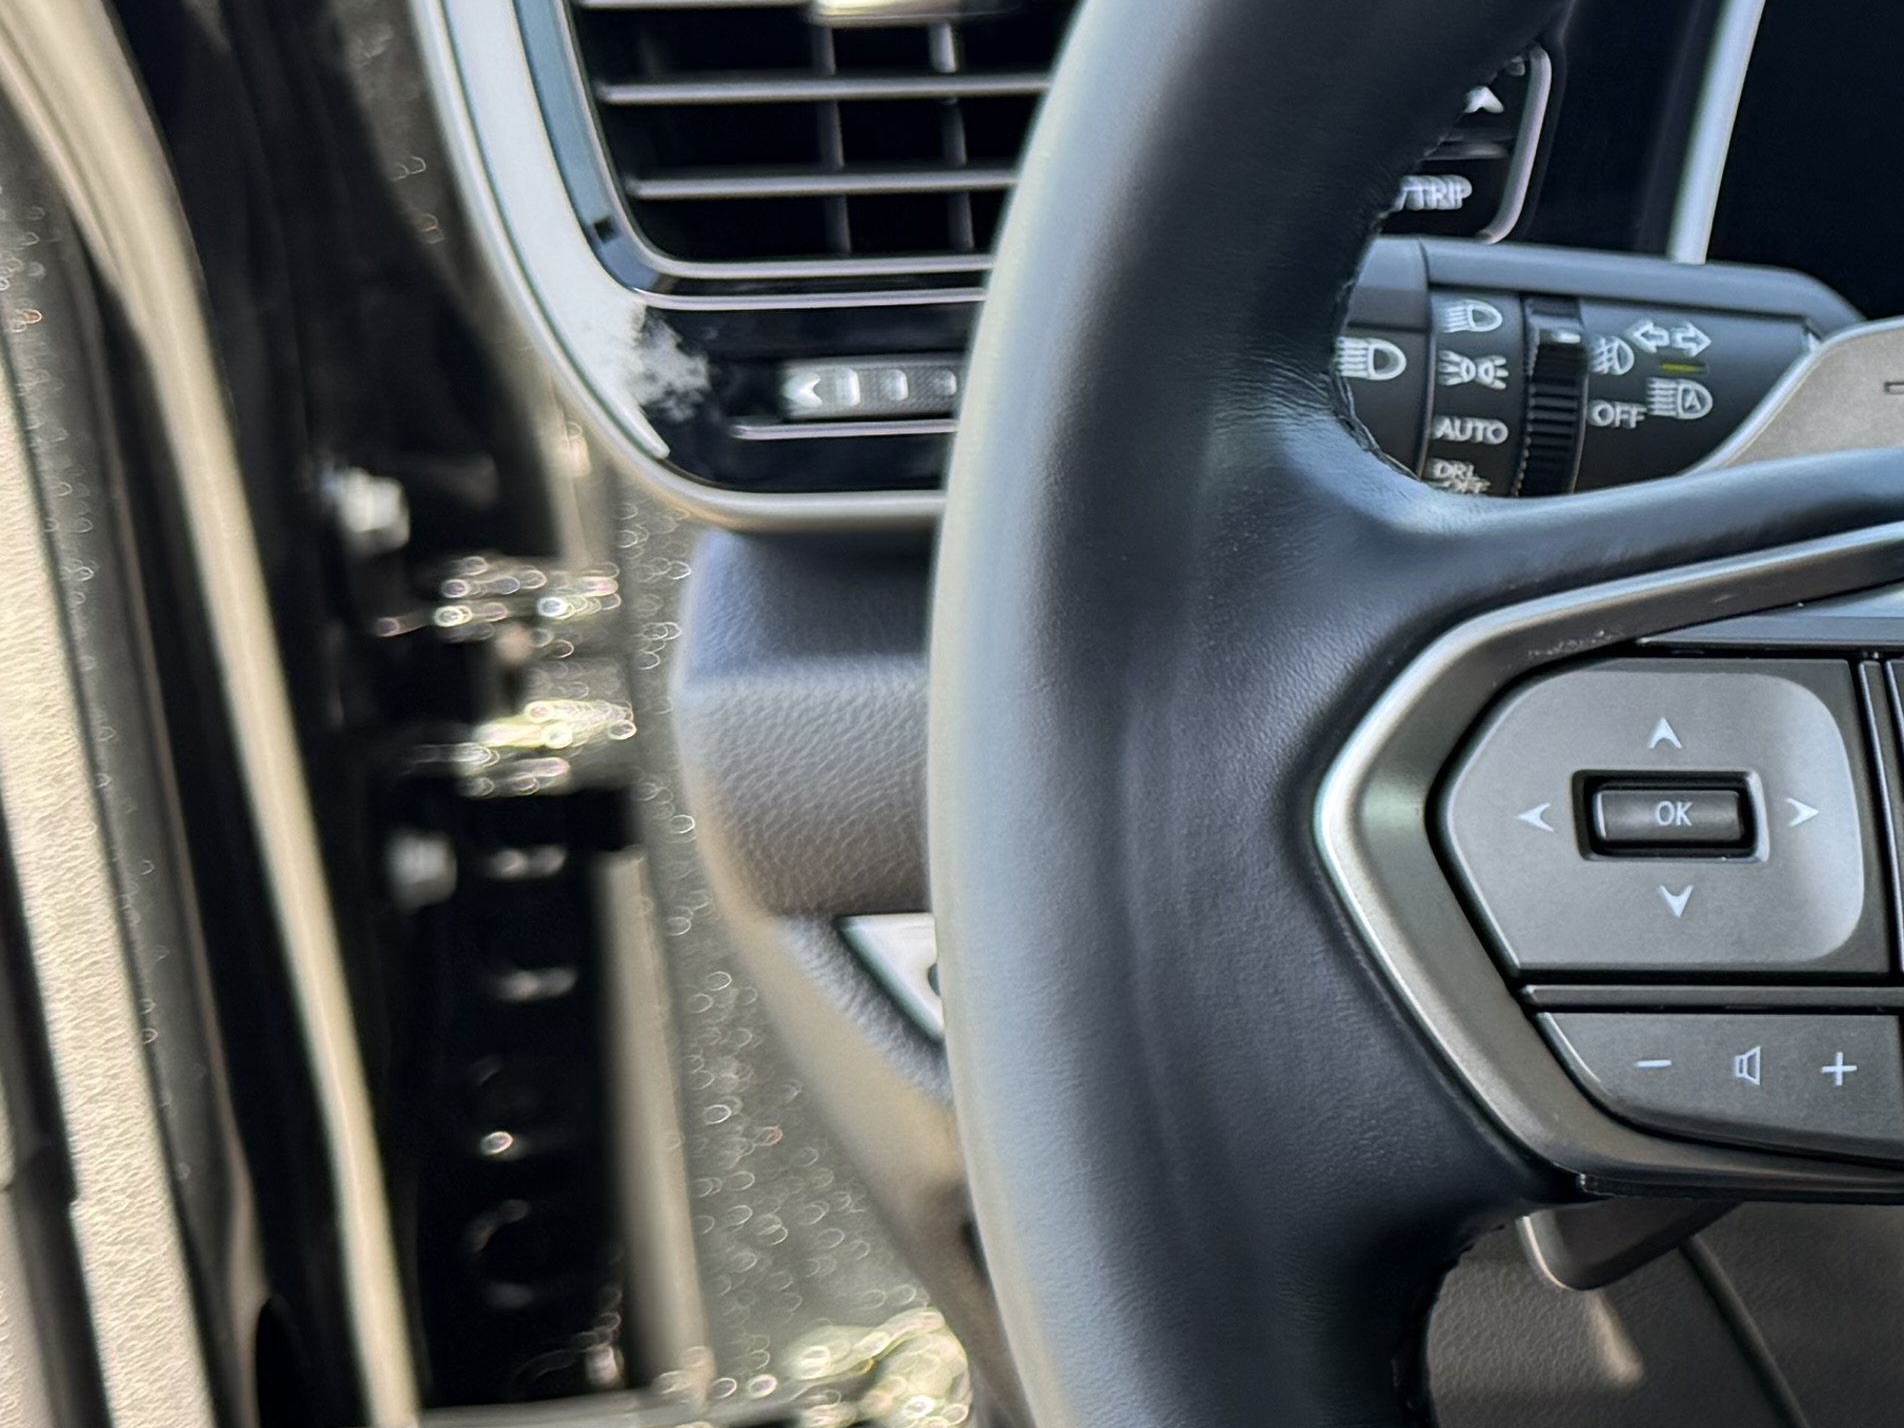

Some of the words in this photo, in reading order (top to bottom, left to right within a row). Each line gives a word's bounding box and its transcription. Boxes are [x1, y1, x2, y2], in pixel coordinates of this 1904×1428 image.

[1589, 400, 1647, 428] OFF
[1431, 416, 1509, 445] AUTO
[1655, 800, 1692, 827] OK
